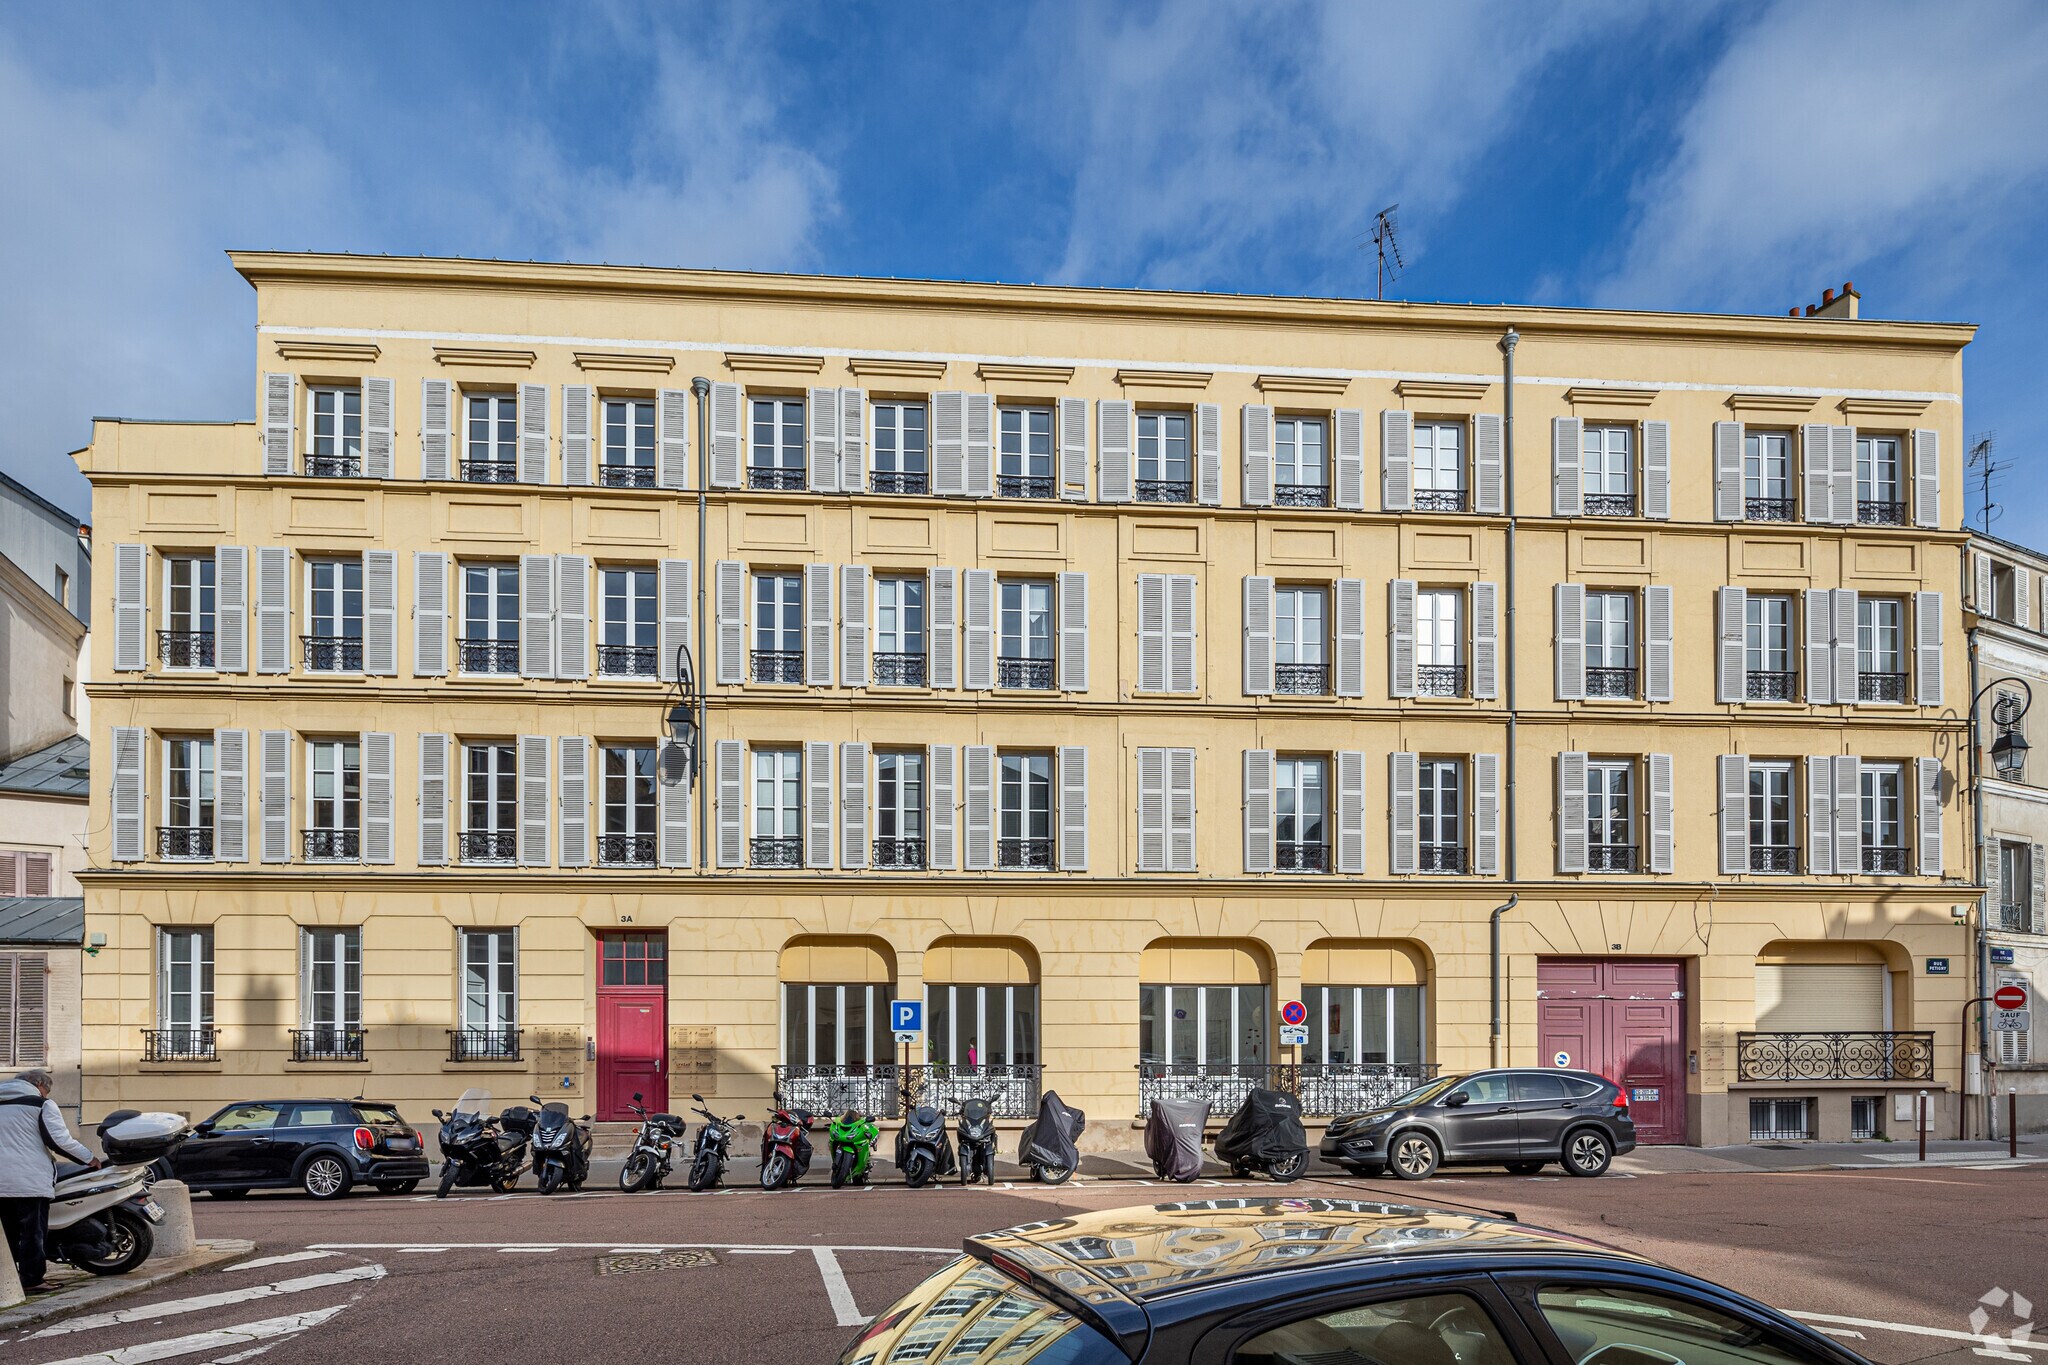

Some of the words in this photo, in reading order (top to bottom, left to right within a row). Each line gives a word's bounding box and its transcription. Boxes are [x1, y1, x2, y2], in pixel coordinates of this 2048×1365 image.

[620, 915, 633, 923] 3A
[1611, 943, 1622, 951] 3B
[900, 1006, 914, 1026] P
